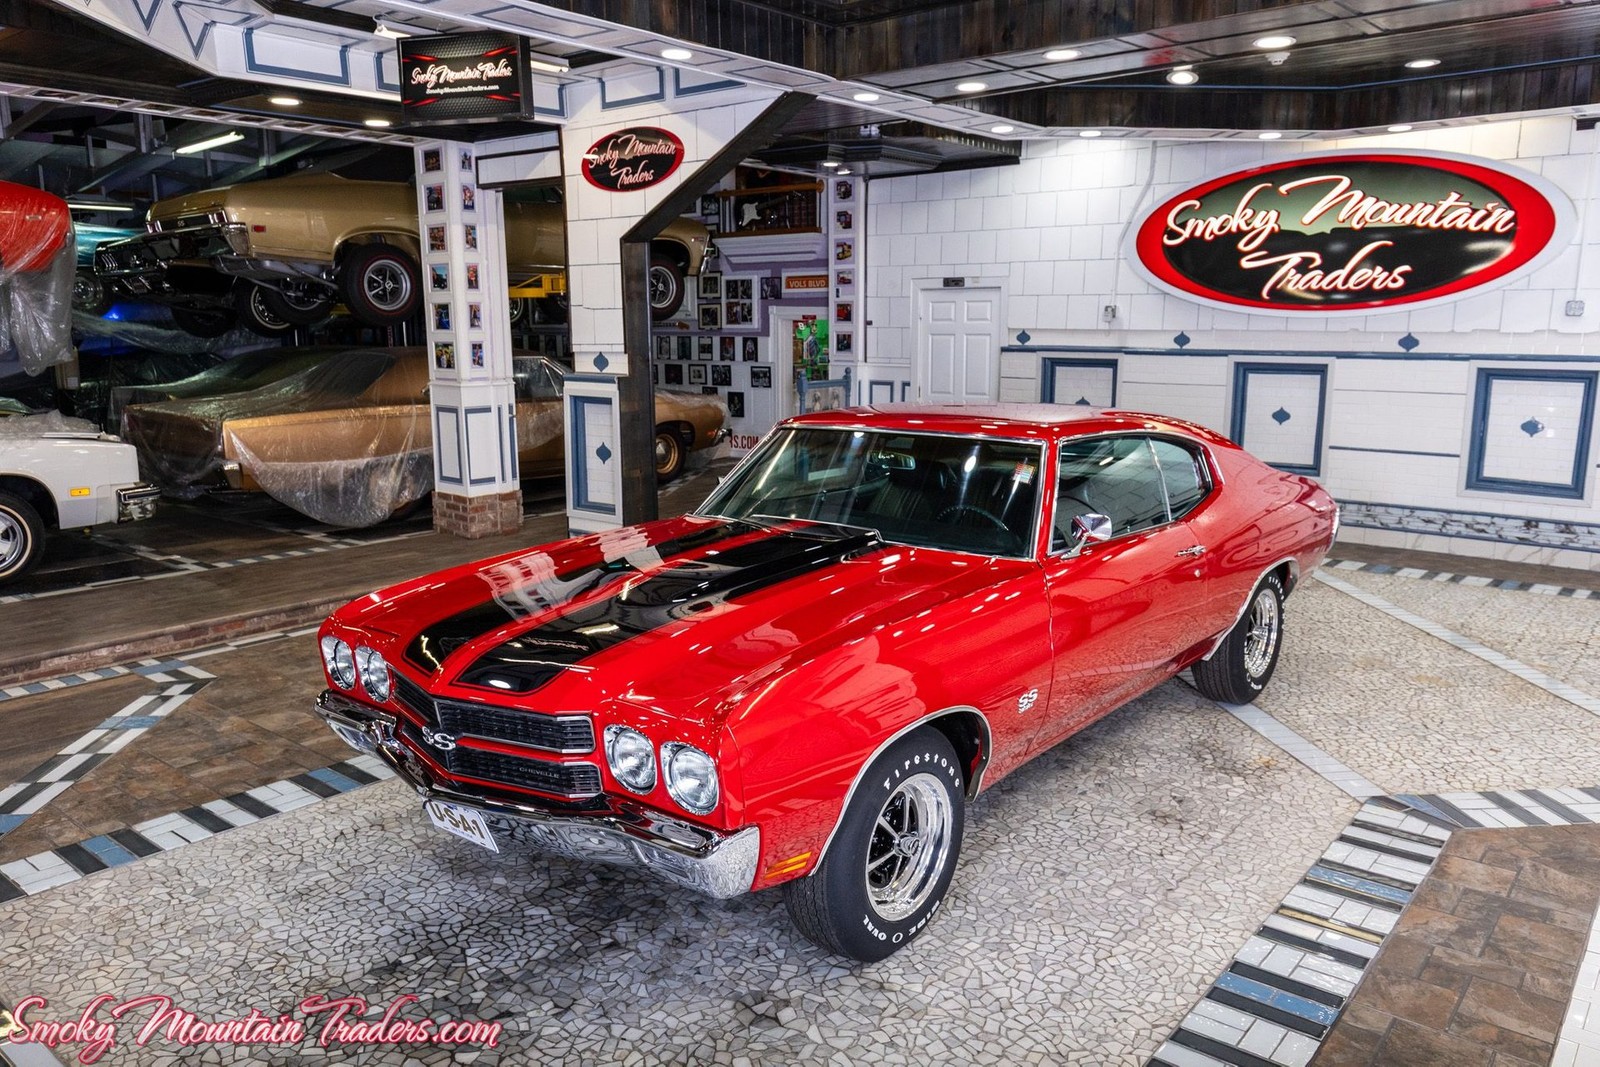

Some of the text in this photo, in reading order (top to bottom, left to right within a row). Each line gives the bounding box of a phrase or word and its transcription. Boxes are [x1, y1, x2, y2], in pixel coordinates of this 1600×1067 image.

[410, 58, 513, 88] Smoky Mountain Traders
[587, 133, 676, 169] Smoky Mountain
[610, 160, 655, 189] Traders
[1162, 173, 1517, 253] Smoky Mountain
[789, 279, 826, 288] VOLS BLVD
[1239, 240, 1414, 301] Traders
[1018, 688, 1039, 707] SS
[421, 725, 457, 750] SS
[518, 766, 561, 780] CHEVELLE
[863, 914, 887, 940] OVAL
